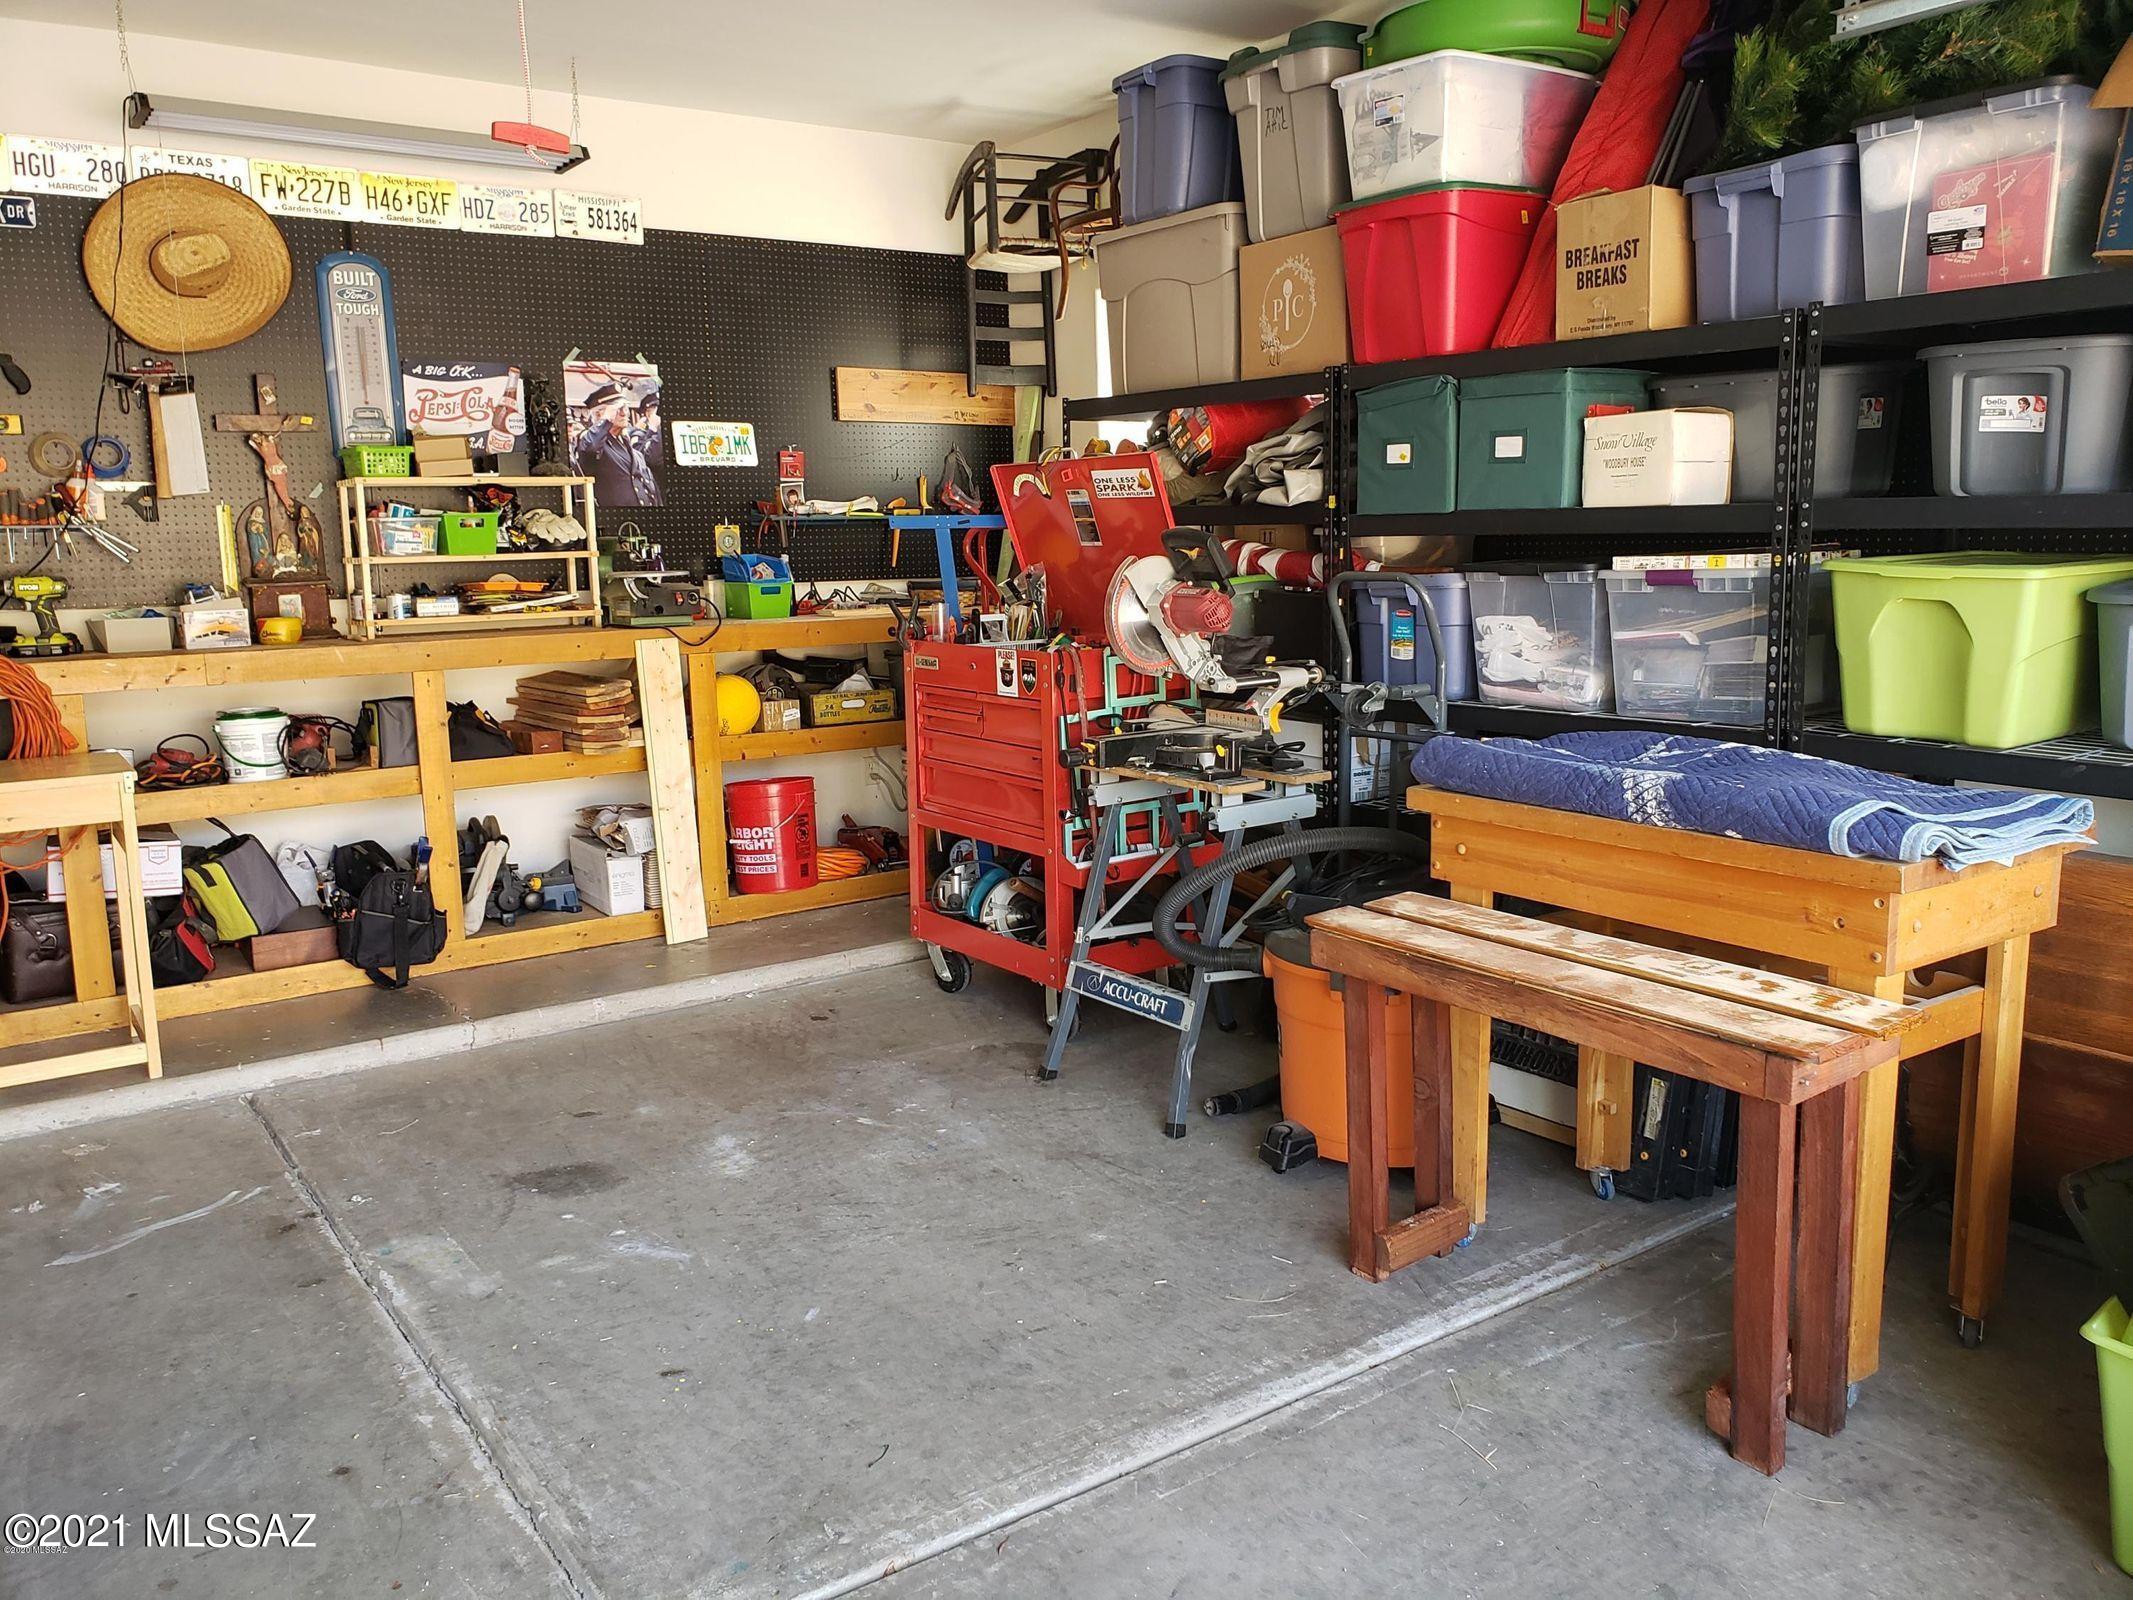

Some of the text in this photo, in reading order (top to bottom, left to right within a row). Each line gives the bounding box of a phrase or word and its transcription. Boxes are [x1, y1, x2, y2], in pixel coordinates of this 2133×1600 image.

[12, 151, 55, 178] HGU
[85, 157, 127, 185] 280
[168, 154, 213, 168] TEXAS
[47, 181, 98, 193] HARRISON
[578, 196, 620, 207] MISSISSIPPI
[6, 204, 25, 219] DR
[281, 203, 336, 216] Garden State
[462, 197, 550, 224] HDZ 285
[386, 214, 437, 226] Garden State
[587, 207, 638, 234] 581364
[332, 270, 377, 286] BUILT
[1576, 264, 1628, 291] BREAKS
[344, 288, 369, 300] Ford
[336, 302, 380, 316] TOUGH
[411, 364, 422, 375] A
[424, 365, 446, 376] BIG
[1593, 431, 1657, 453] Snow Village
[1096, 483, 1136, 493] SPARK
[1102, 980, 1168, 1014] ACCU-CRAFT
